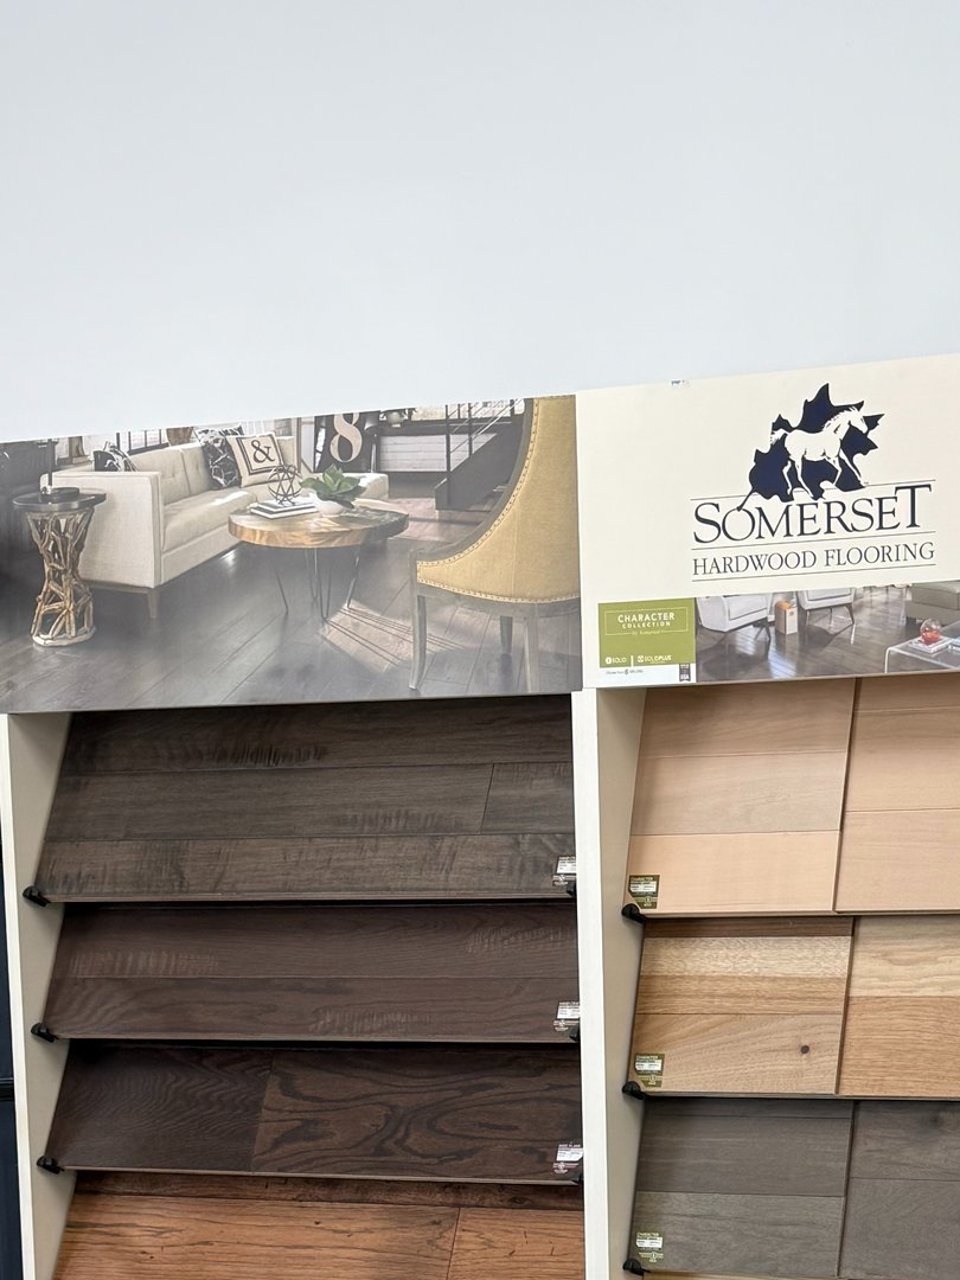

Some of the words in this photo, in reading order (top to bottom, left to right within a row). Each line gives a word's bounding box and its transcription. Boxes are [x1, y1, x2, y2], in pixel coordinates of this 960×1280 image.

[250, 439, 275, 463] &
[693, 484, 932, 544] SOMERSET
[693, 550, 817, 576] HARDWOOD
[824, 541, 935, 567] FLOORING
[617, 612, 675, 623] CHARACTER
[622, 621, 671, 629] COLLECTION
